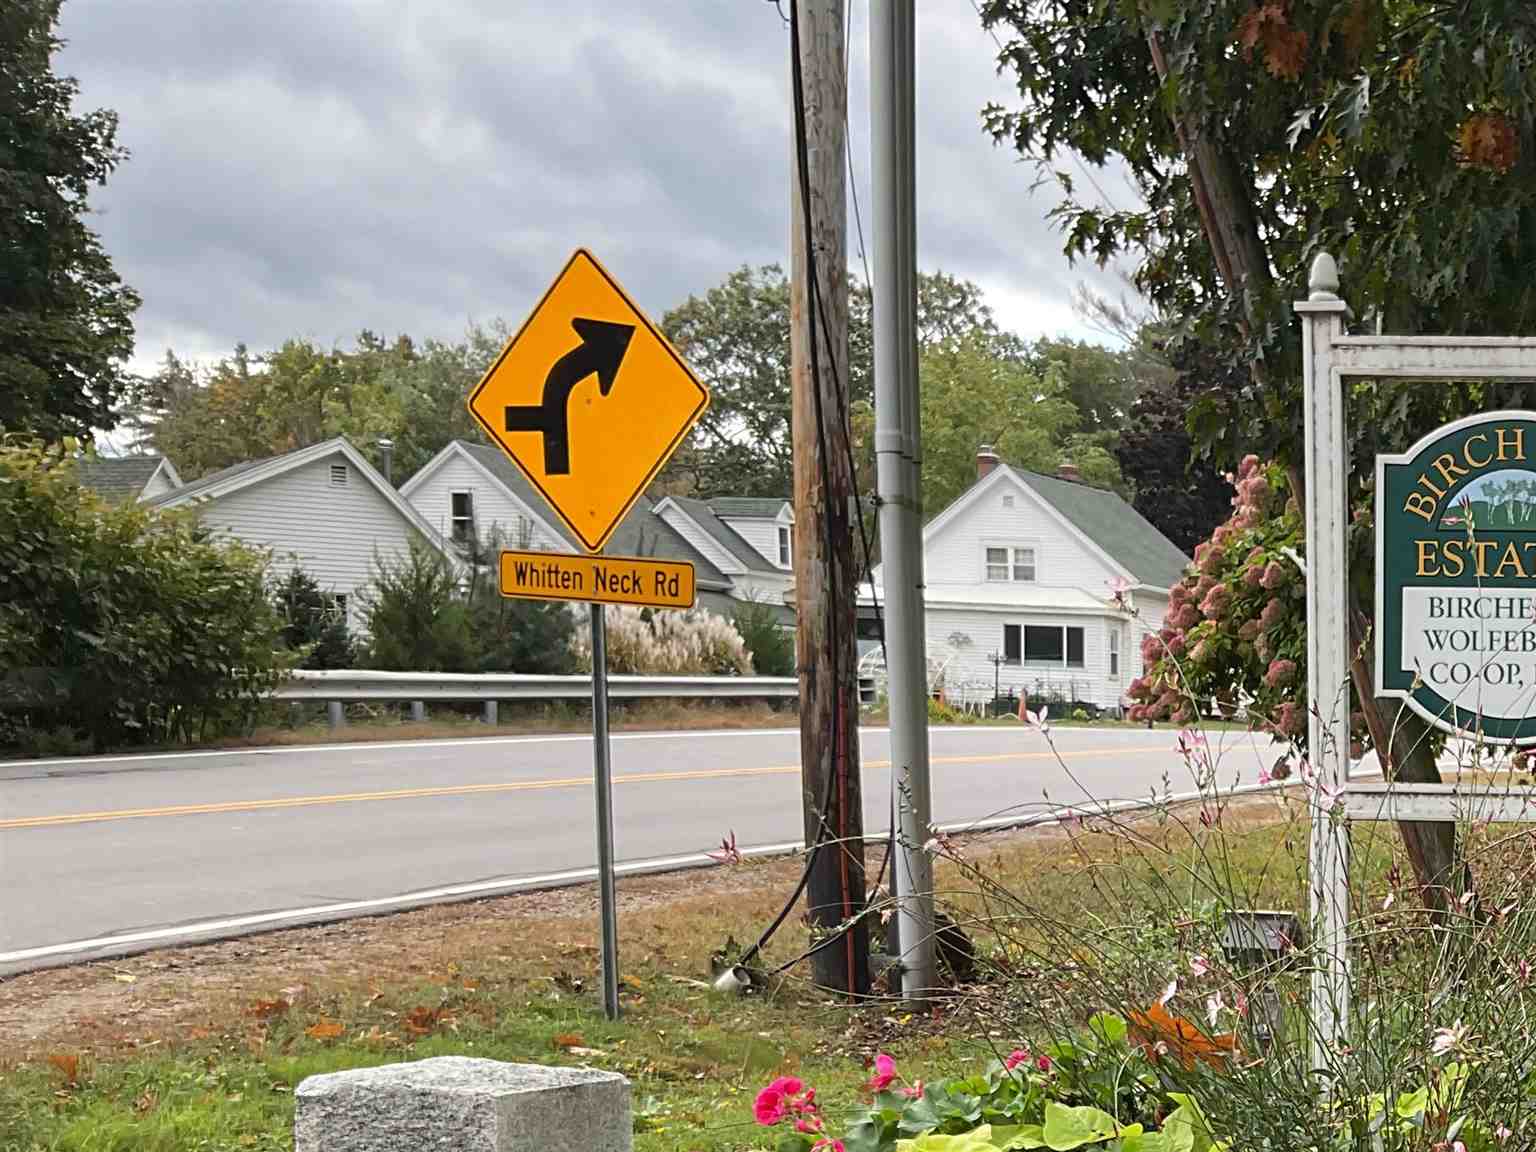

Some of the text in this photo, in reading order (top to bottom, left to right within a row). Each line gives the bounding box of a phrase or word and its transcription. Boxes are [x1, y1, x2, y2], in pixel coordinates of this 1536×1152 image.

[1403, 428, 1526, 522] BIRCH
[514, 560, 679, 597] Whitten Neck Rd
